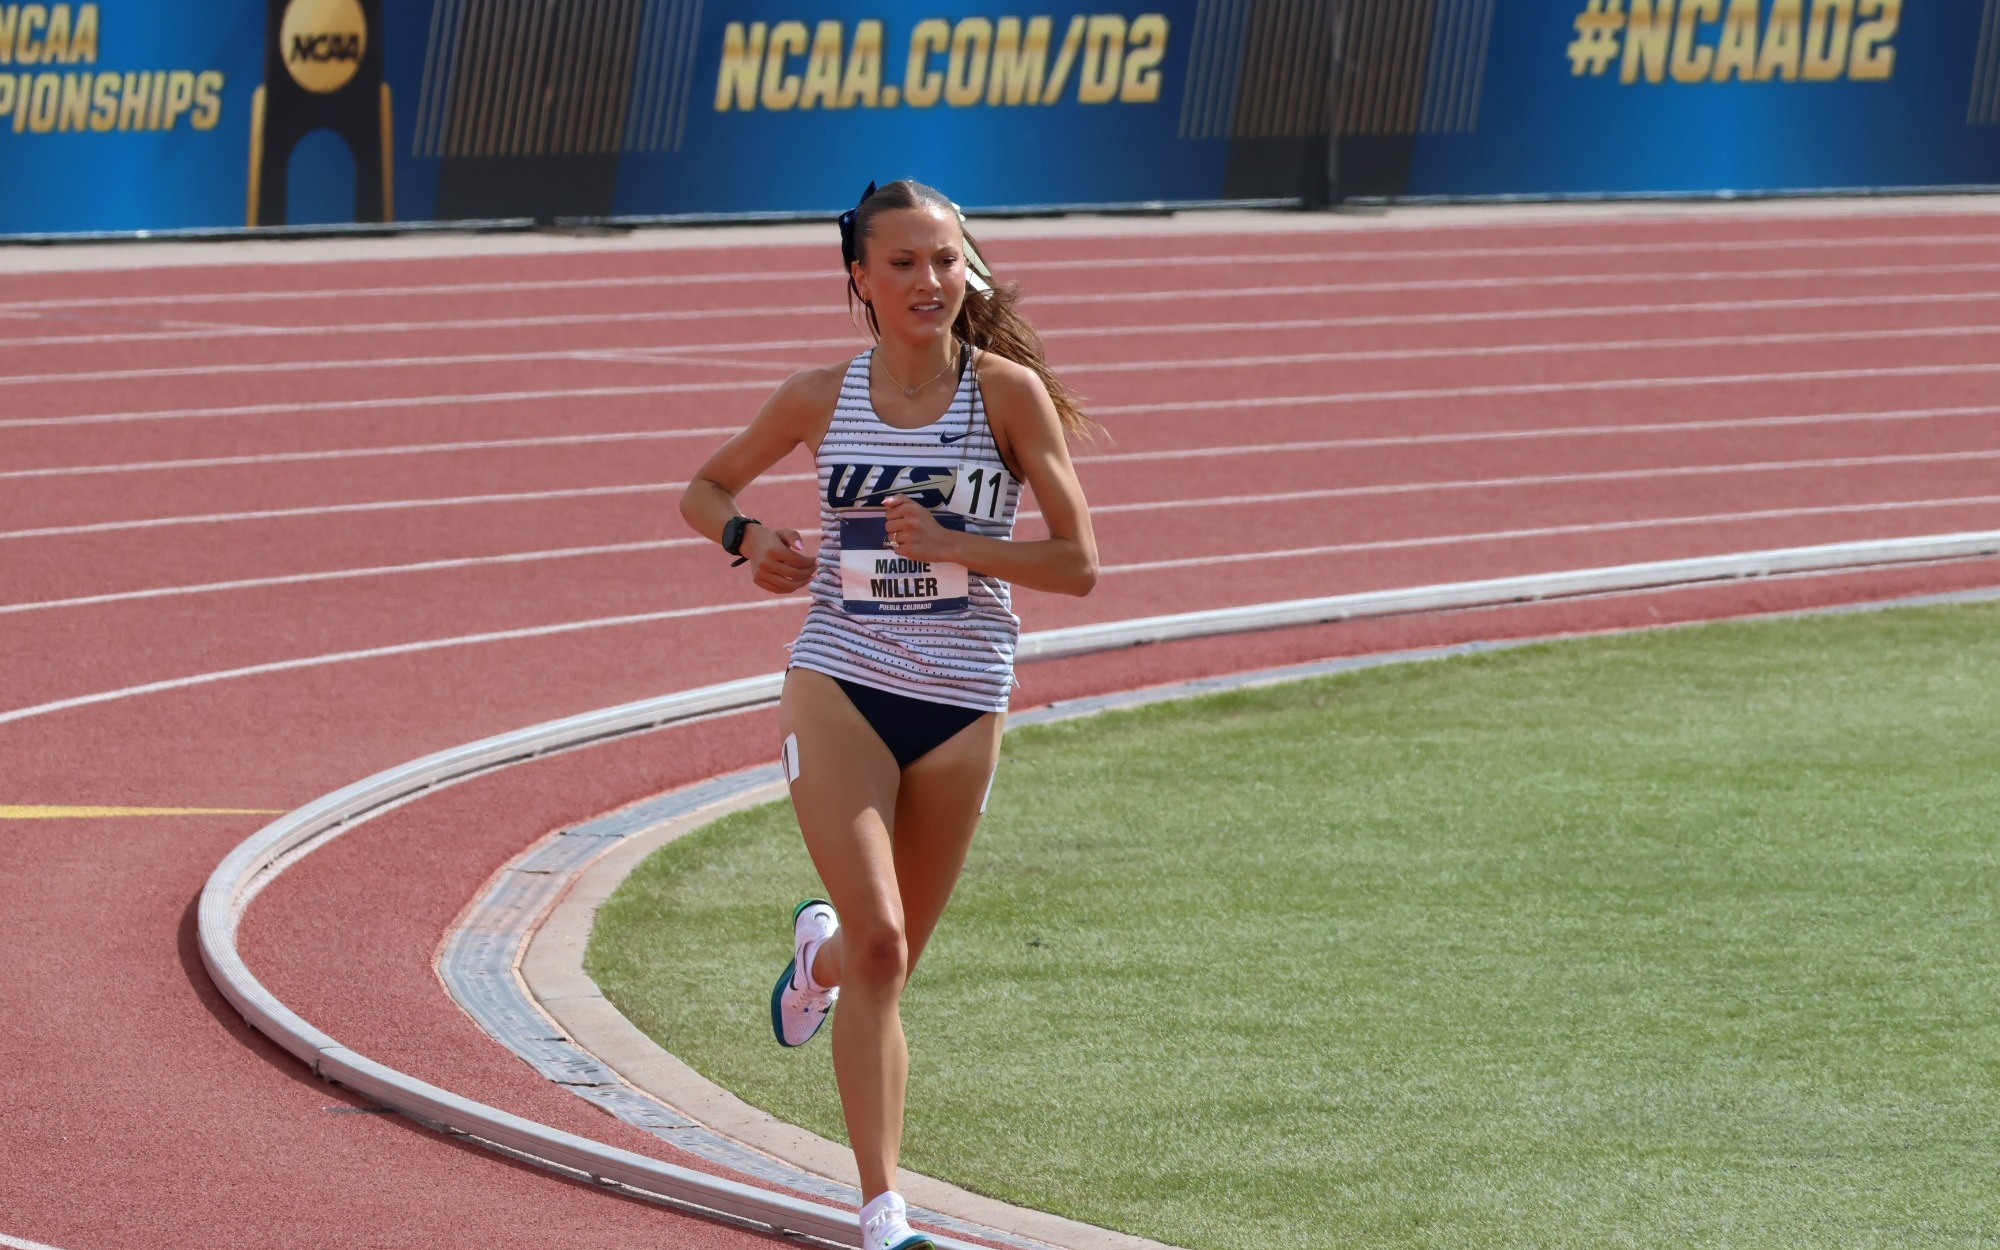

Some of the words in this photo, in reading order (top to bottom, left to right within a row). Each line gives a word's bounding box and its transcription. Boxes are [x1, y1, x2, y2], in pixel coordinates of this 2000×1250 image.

[290, 32, 360, 64] NCAA
[1568, 0, 1901, 84] #NCAAD2
[714, 14, 1169, 111] NCAA.COM/D2
[967, 468, 1002, 518] 11
[875, 558, 931, 574] MADDIE
[870, 577, 938, 598] MILLER
[902, 603, 932, 611] COLORADO
